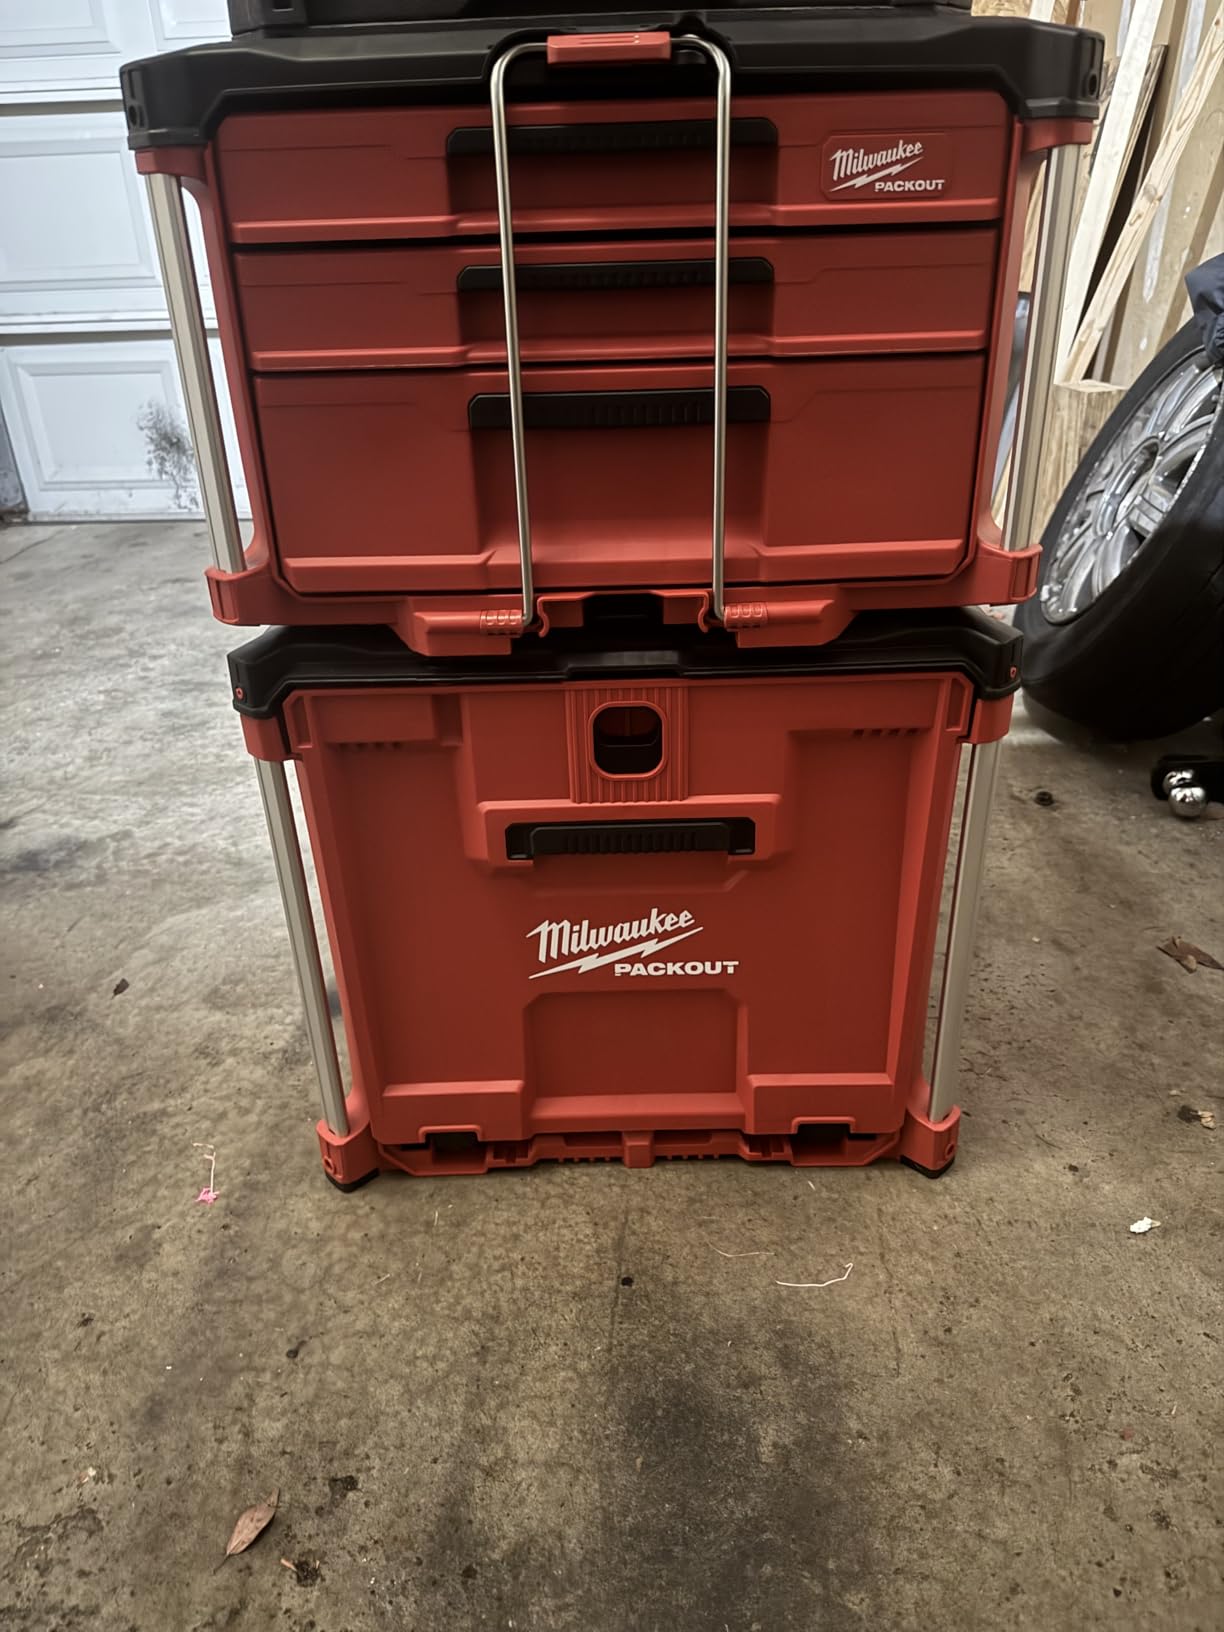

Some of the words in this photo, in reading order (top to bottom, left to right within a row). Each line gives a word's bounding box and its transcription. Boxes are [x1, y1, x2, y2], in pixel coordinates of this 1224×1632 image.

[829, 140, 923, 181] Milwaukee
[874, 180, 945, 192] PACKOUT
[526, 908, 695, 964] Milwaukee
[614, 961, 739, 976] PACKOUT
